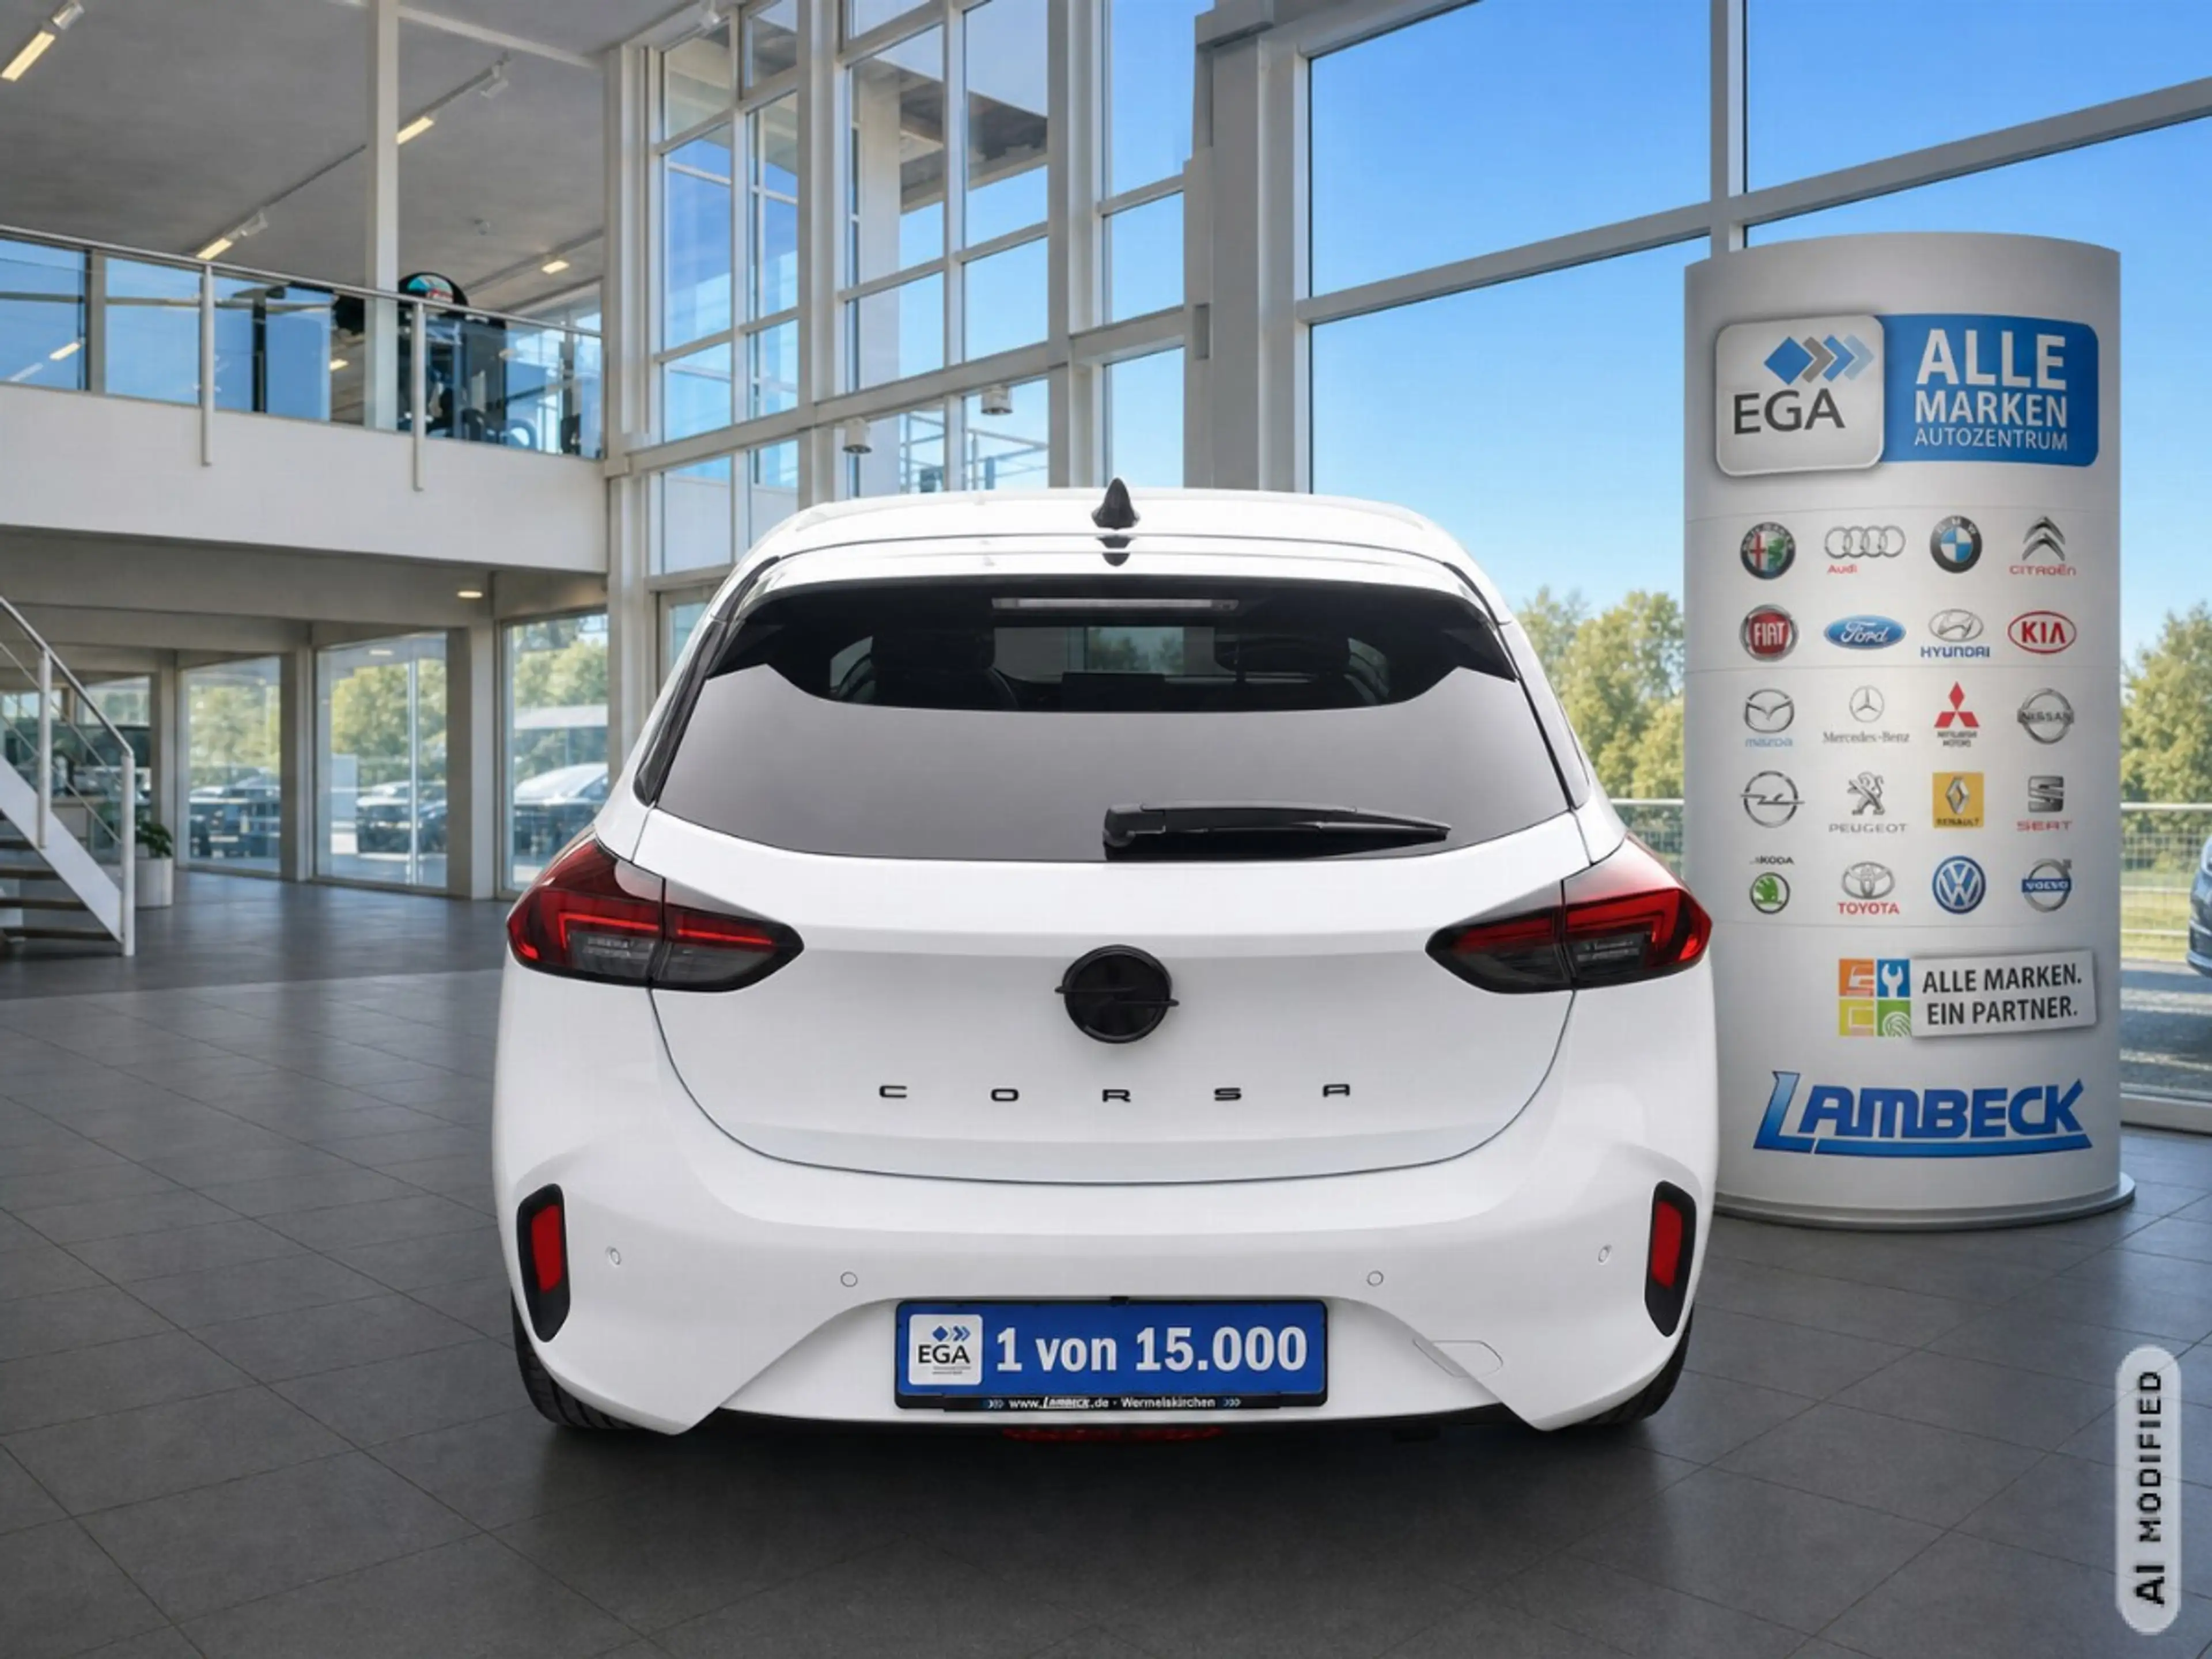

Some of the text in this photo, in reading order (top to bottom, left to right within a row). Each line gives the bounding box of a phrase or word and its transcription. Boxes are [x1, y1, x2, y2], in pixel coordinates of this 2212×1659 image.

[1916, 329, 2067, 391] ALLE
[1733, 388, 1846, 435] EGA
[1915, 391, 2068, 428] MARKEN
[1914, 427, 2068, 452] AUTOZENTRUM
[1827, 563, 1858, 574] Audi
[1753, 622, 1786, 647] FIAT
[1840, 620, 1889, 645] Ford
[2021, 621, 2066, 644] KIA
[1920, 646, 1991, 658] HYUNDAI
[1822, 730, 1910, 744] Mercedes-Benz
[1828, 823, 1908, 834] PEUGEOT
[2016, 820, 2073, 832] SEAT
[2025, 880, 2069, 890] VOLVO
[1838, 902, 1900, 915] TOYOTA
[1923, 963, 2082, 994] ALLE MARKEN.
[1927, 995, 2078, 1026] EIN PARTNER.
[878, 1083, 1351, 1103] CORSA
[1753, 1070, 2086, 1154] LAMBECK
[918, 1344, 971, 1365] EGA
[996, 1326, 1308, 1372] 1 von 15.000
[1120, 1396, 1216, 1408] Wermelskirchen
